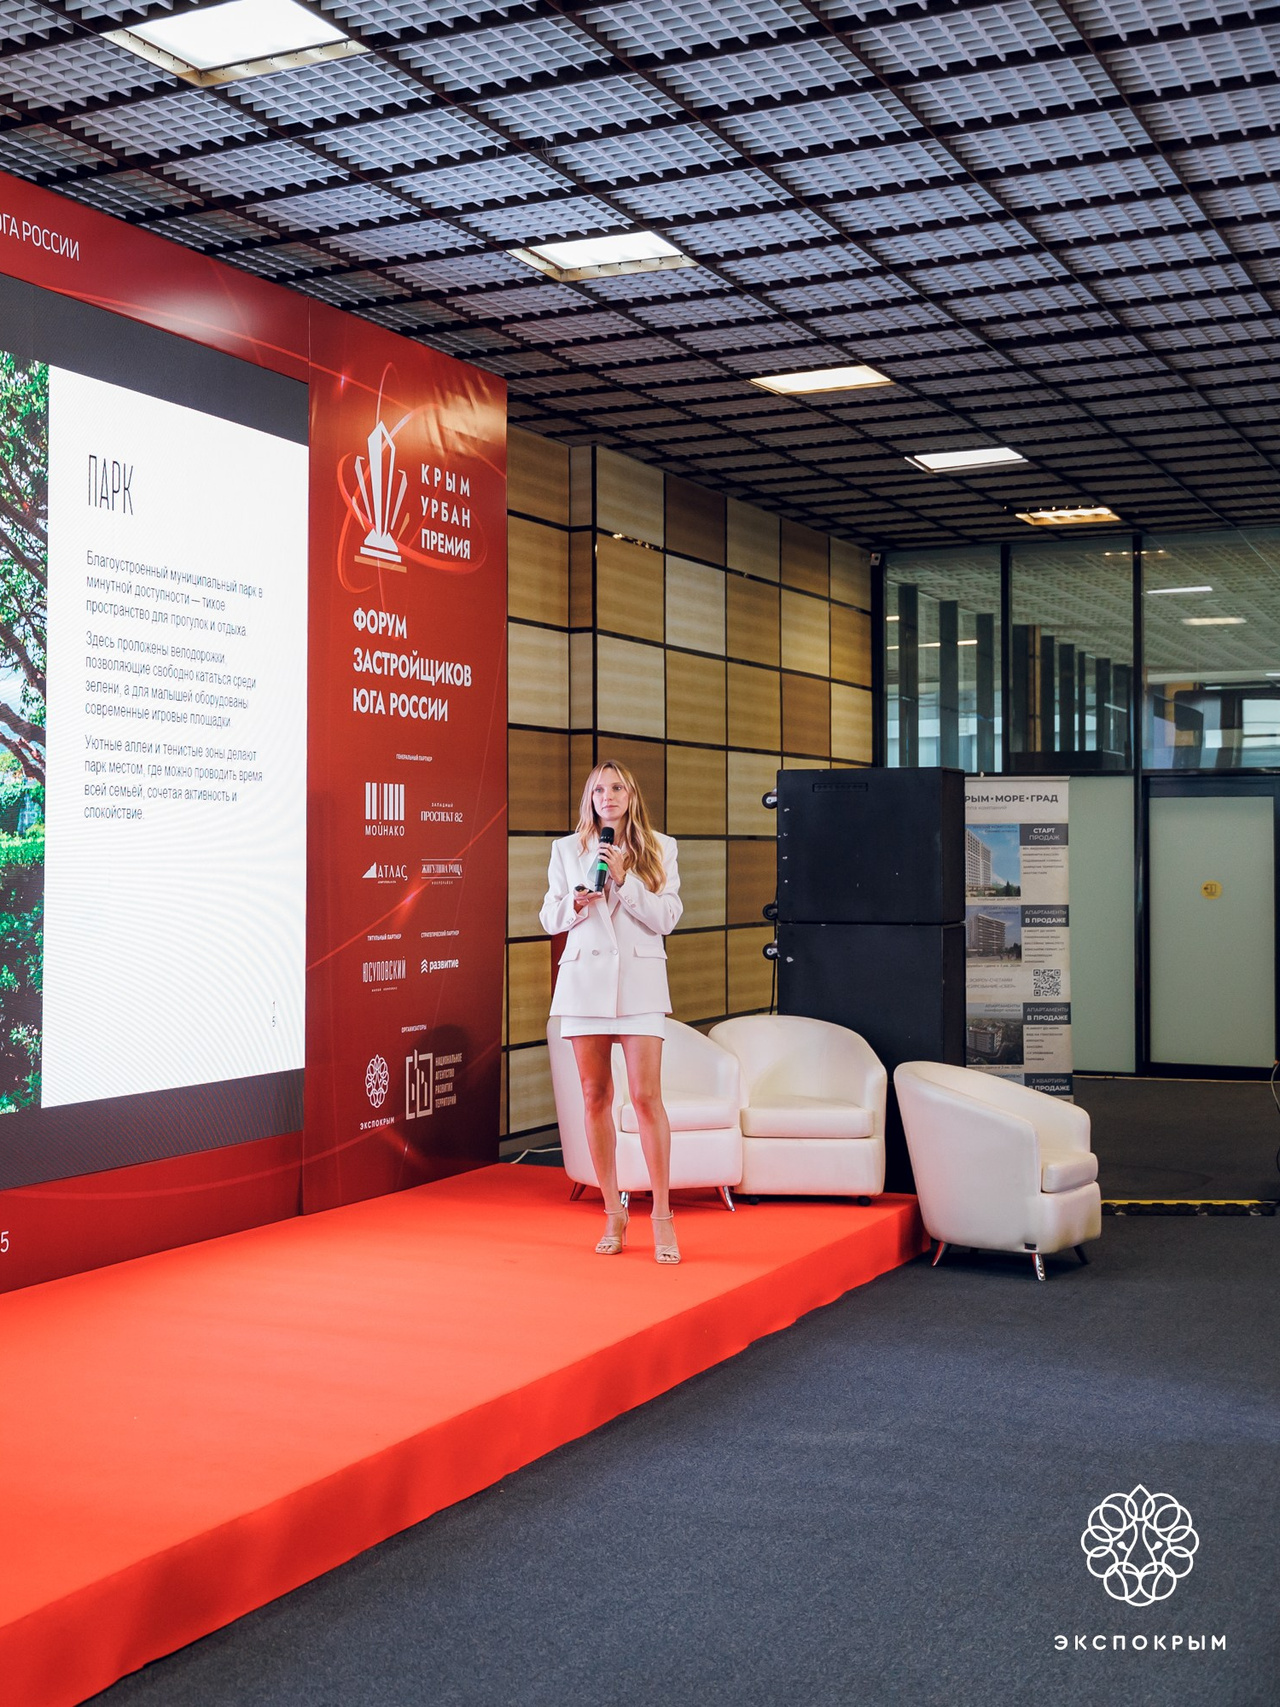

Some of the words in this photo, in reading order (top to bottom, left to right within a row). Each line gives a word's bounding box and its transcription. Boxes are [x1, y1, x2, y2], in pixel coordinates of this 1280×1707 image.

[22, 220, 80, 261] РОССИИ
[87, 454, 134, 516] ПАРК
[421, 463, 470, 498] КРЫМ
[420, 495, 470, 529] УРБАН
[421, 528, 470, 560] ПРЕМИЯ
[86, 549, 169, 579] Благоустроенный
[170, 569, 237, 592] муниципальный
[238, 583, 257, 598] парк
[258, 587, 263, 598] в
[86, 575, 132, 595] минутной
[134, 584, 190, 605] доступности
[202, 596, 226, 611] тихое
[85, 598, 150, 621] пространство
[151, 609, 168, 624] для
[170, 613, 209, 631] прогулок
[209, 620, 216, 631] и
[353, 607, 407, 639] ФОРУМ
[85, 630, 115, 649] Здесь
[117, 638, 169, 656] проложены
[85, 656, 151, 677] позволяющие
[152, 664, 194, 682] свободно
[195, 671, 232, 686] кататься
[232, 675, 257, 691] среди
[353, 647, 472, 687] ЗАСТРОЙЩИКОВ
[85, 679, 122, 699] зелени,
[123, 684, 130, 696] а
[131, 684, 149, 700] для
[151, 687, 193, 703] малышей
[194, 690, 249, 710] оборудованы
[353, 688, 386, 715] ЮГА
[389, 693, 448, 722] РОССИИ
[84, 702, 150, 720] современные
[151, 708, 188, 724] игровые
[84, 734, 122, 752] Уютные
[124, 740, 153, 754] аллеи
[154, 743, 161, 754] и
[163, 743, 204, 758] тенистые
[205, 747, 226, 760] зоны
[226, 748, 257, 762] делают
[84, 759, 107, 775] парк
[108, 762, 146, 778] местом,
[147, 764, 162, 778] где
[164, 765, 193, 778] можно
[194, 767, 238, 782] проводить
[238, 769, 263, 784] время
[84, 782, 107, 796] всей
[147, 786, 183, 800] сочетая
[184, 788, 231, 802] активность
[231, 790, 238, 802] и
[84, 804, 146, 820] спокойствие.
[420, 810, 454, 822] ПРОСПЕКТ
[454, 812, 464, 823] 82
[365, 821, 405, 836] МОЙНАКО
[362, 956, 406, 983] ЮСУПОВСКИЙ
[429, 959, 459, 973] развитие
[359, 1116, 395, 1130] ЭКСПОКРЫМ
